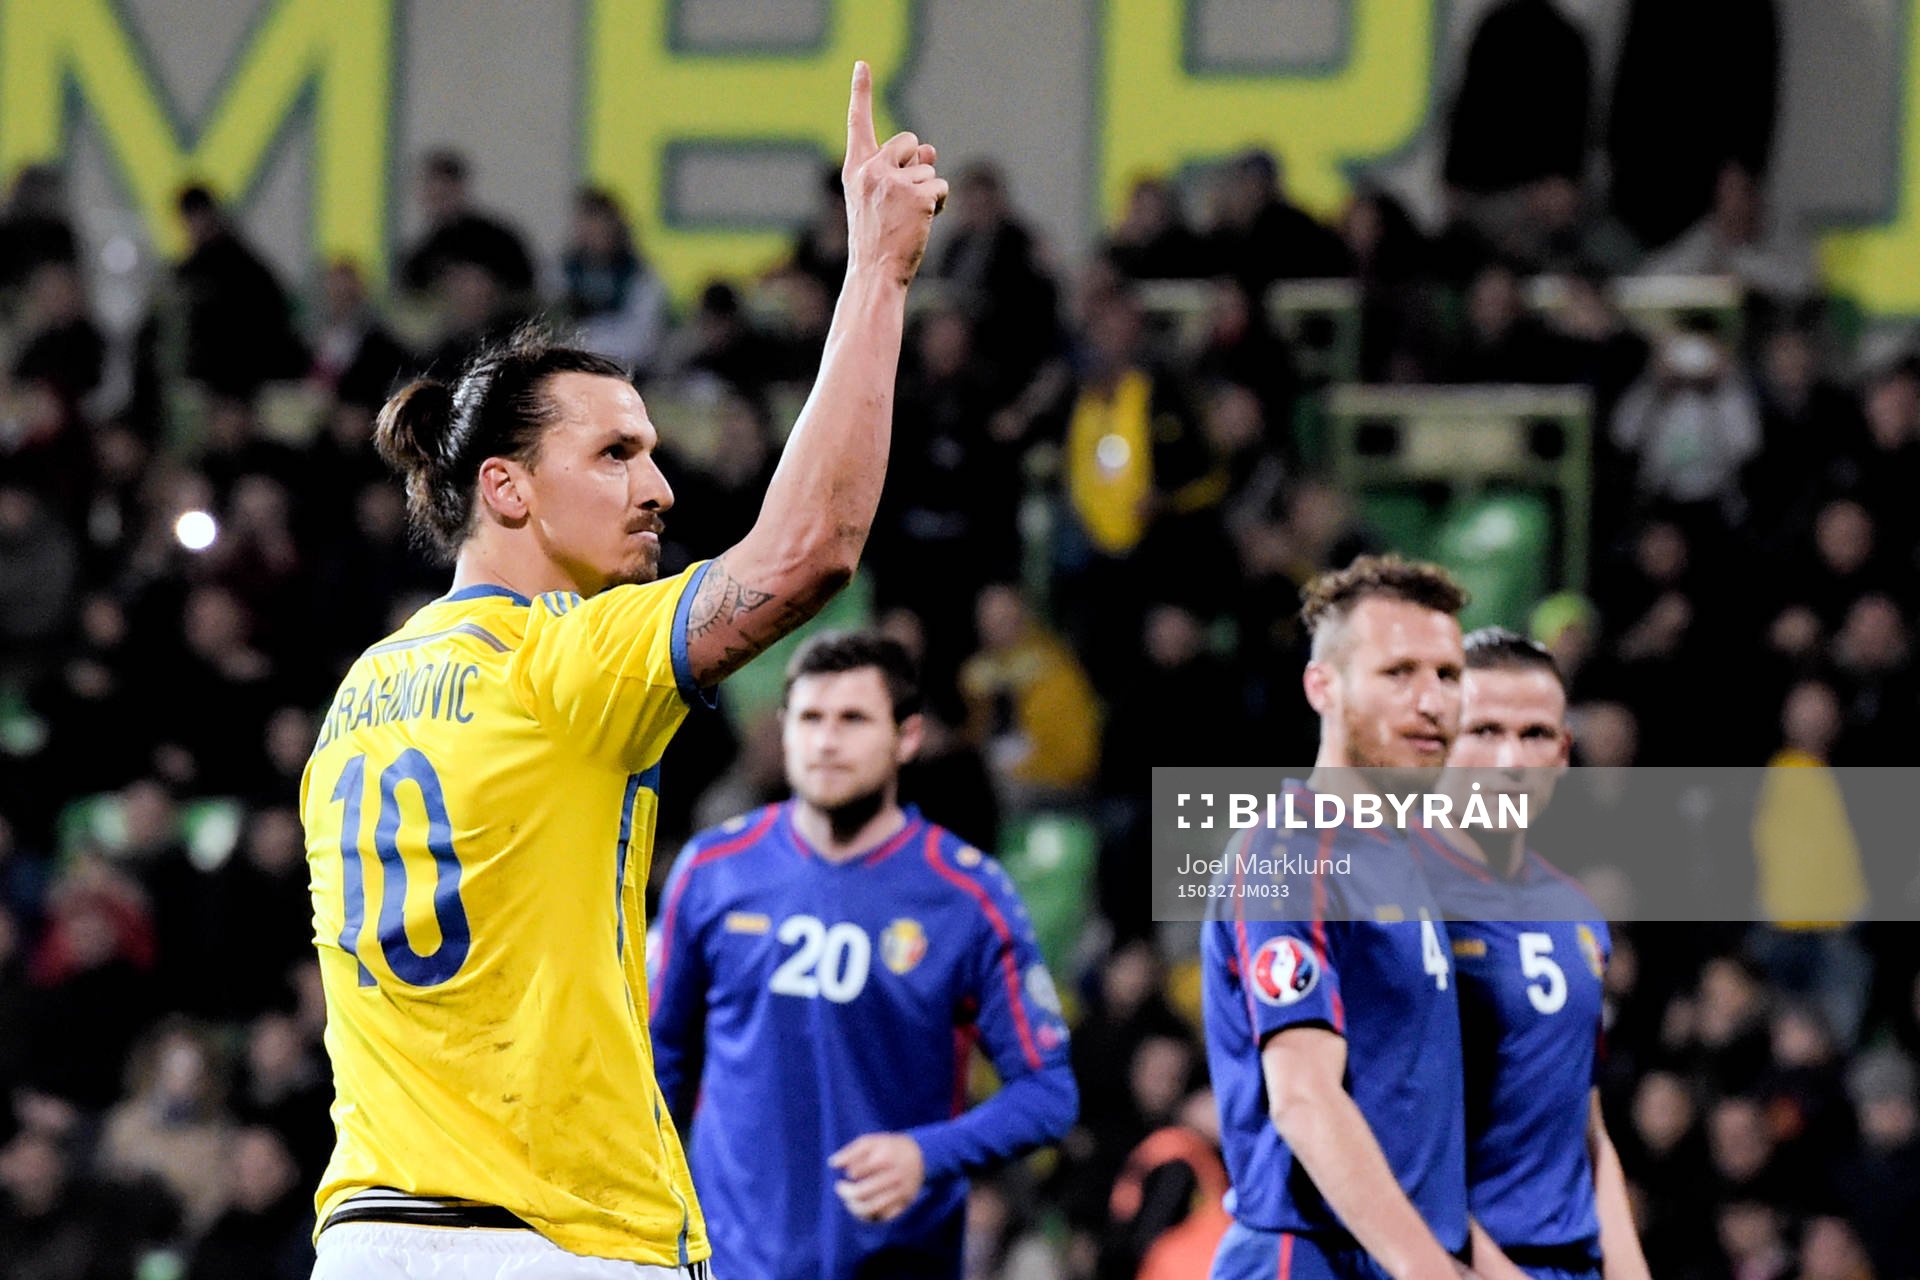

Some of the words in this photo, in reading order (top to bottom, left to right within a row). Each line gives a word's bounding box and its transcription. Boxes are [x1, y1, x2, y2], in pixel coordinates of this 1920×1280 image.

[330, 748, 471, 987] 10
[769, 914, 871, 1004] 20
[1418, 905, 1449, 992] 4
[1517, 931, 1569, 1016] 5
